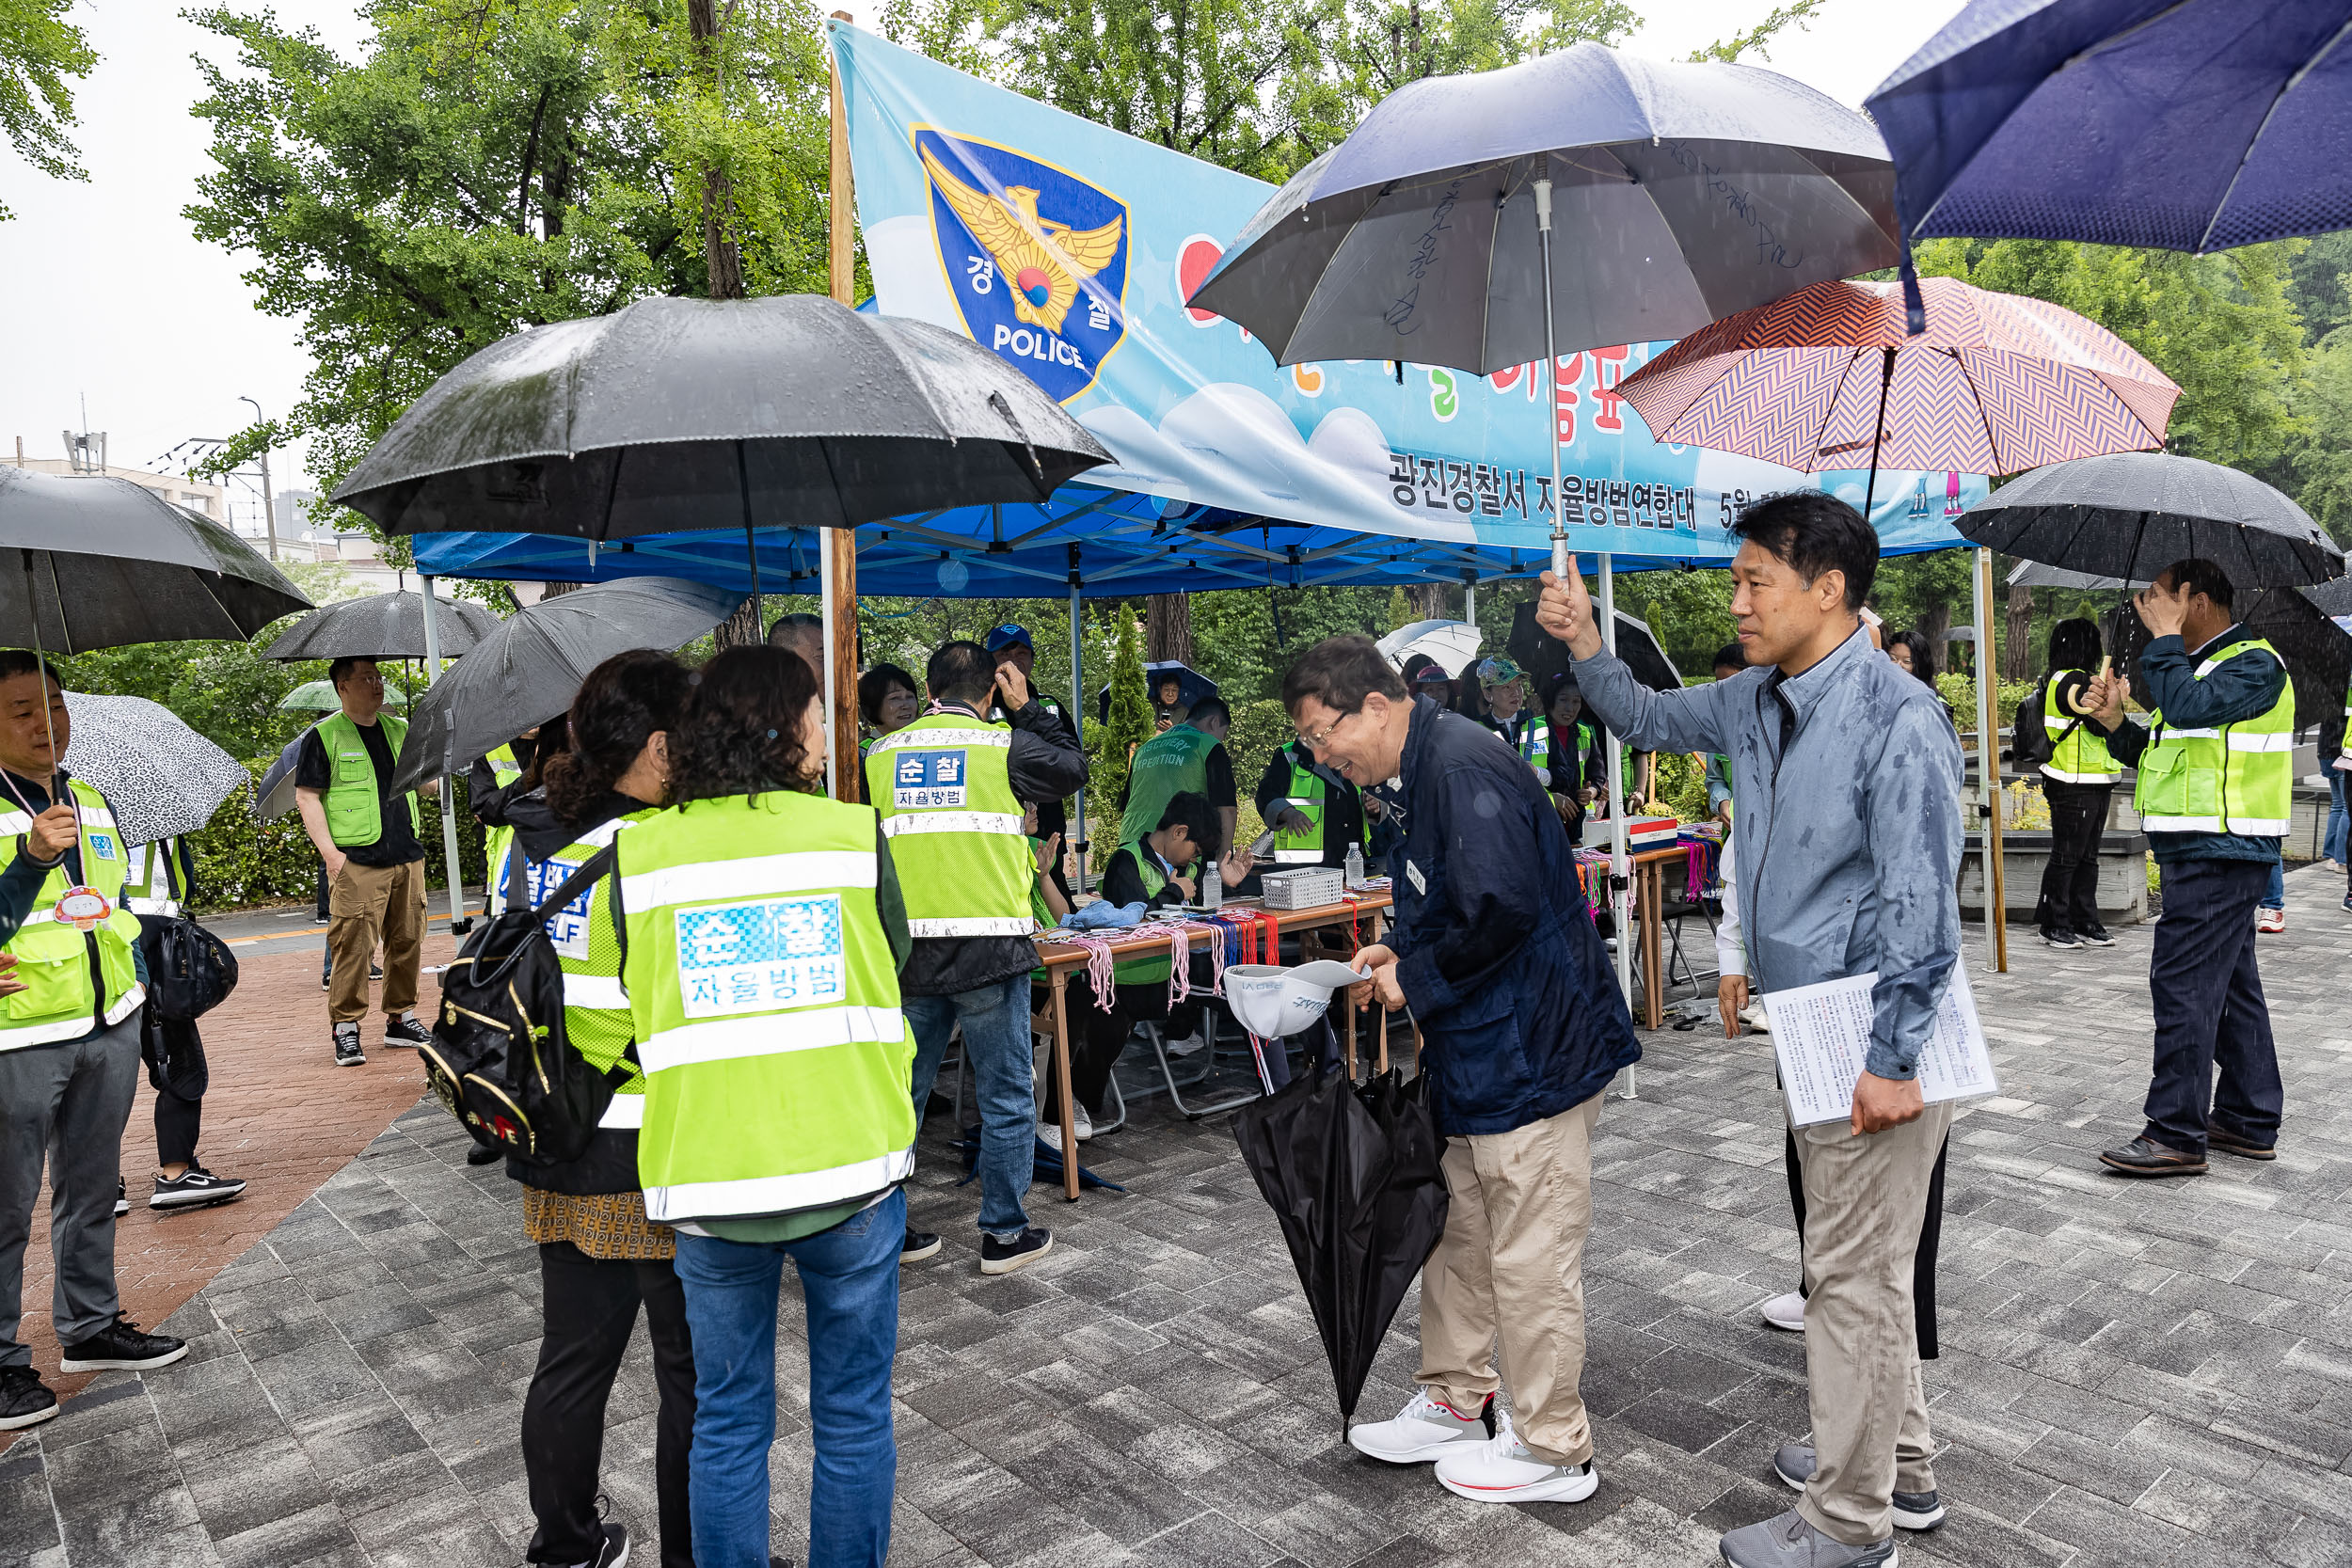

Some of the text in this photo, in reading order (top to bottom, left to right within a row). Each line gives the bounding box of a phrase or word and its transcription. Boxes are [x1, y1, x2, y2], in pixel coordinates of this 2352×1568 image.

[966, 255, 993, 295] 경
[1088, 293, 1111, 332] 찰
[993, 324, 1086, 371] POLICE
[1389, 452, 1529, 520] 광진경찰서
[898, 790, 961, 805] 자율방범
[691, 962, 836, 1006] 자율방범
